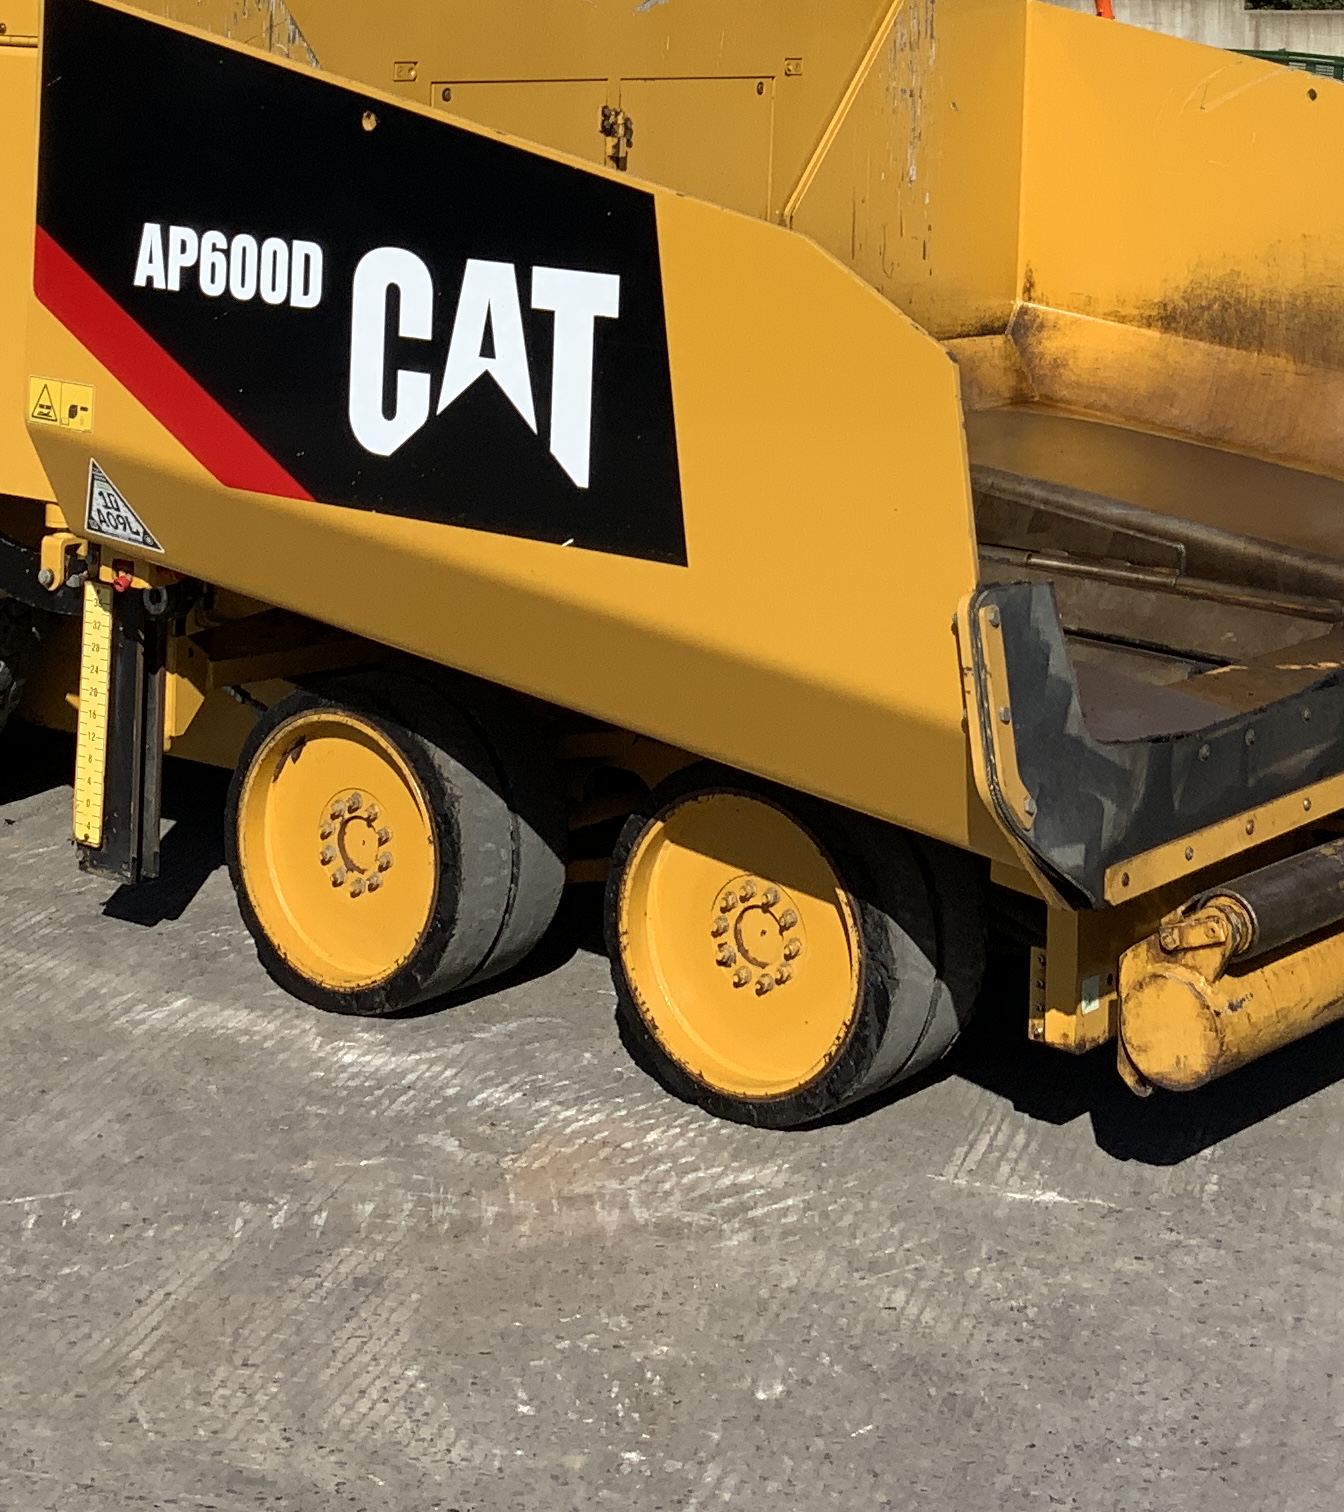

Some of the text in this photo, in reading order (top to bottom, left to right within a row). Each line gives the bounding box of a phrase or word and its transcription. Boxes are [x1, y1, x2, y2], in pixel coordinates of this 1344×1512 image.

[134, 223, 322, 308] AP600D
[349, 246, 620, 488] CAT
[92, 620, 101, 630] 32
[90, 665, 98, 675] 24
[89, 687, 97, 697] 20
[88, 710, 96, 719] 16
[88, 732, 95, 741] 12
